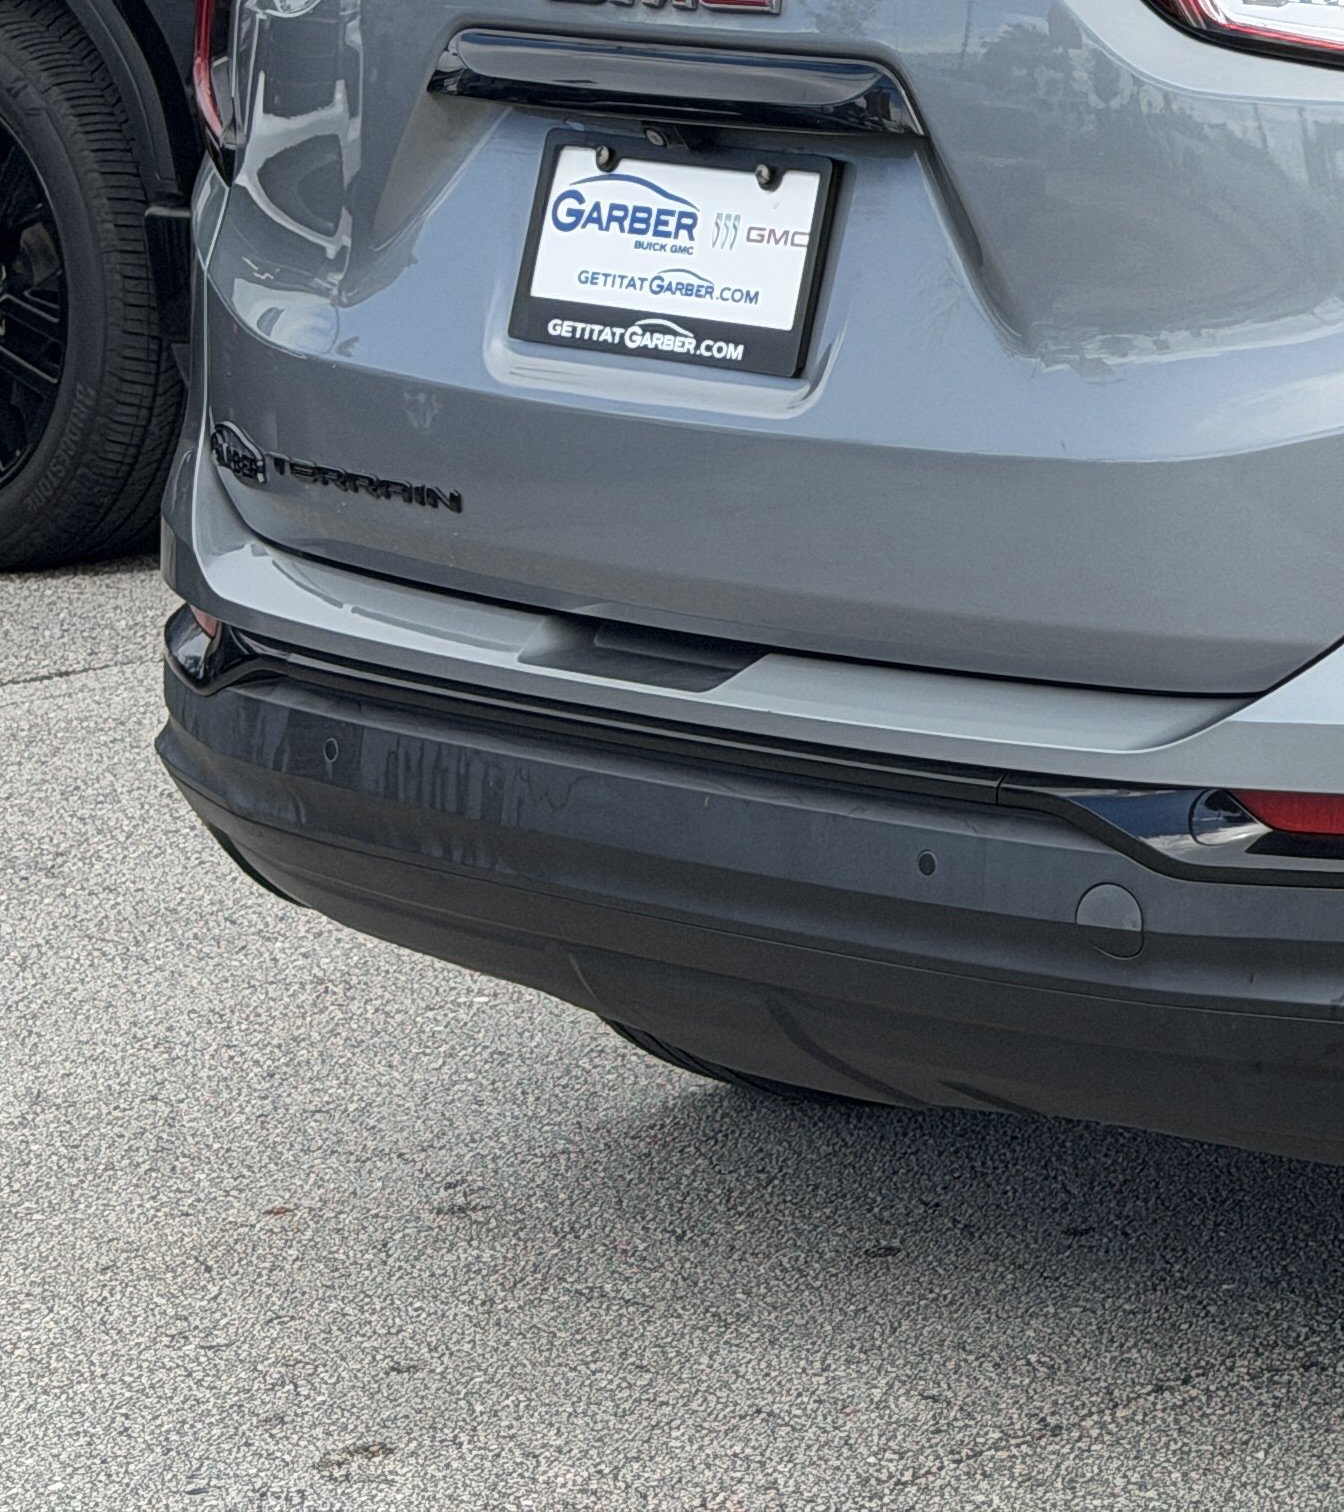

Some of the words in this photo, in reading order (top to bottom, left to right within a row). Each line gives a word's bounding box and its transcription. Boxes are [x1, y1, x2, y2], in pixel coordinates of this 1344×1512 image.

[551, 189, 699, 243] GARBER
[633, 240, 667, 254] BUICK
[670, 243, 695, 256] GMC
[267, 451, 463, 514] TERRAIN
